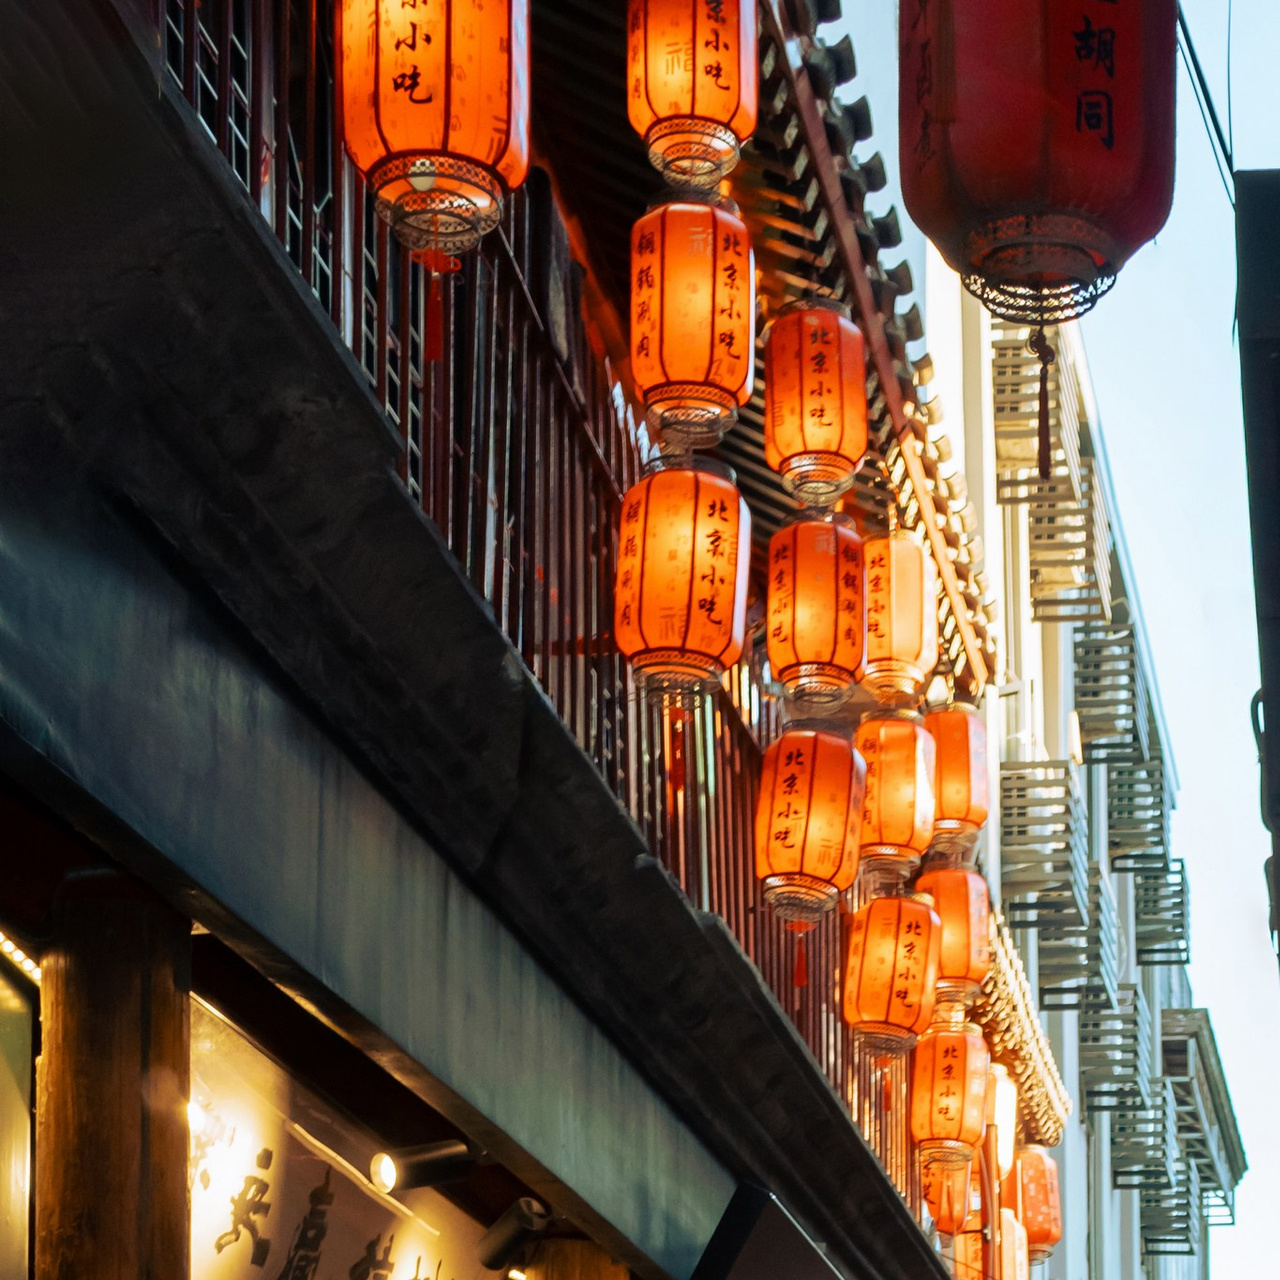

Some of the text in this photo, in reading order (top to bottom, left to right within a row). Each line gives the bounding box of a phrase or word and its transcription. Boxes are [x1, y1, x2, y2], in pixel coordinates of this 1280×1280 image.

[1072, 0, 1119, 151] 胡同
[718, 232, 742, 361] 北京小吃
[808, 328, 832, 427] 北京小吃
[698, 498, 729, 626] 北京小吃
[773, 748, 805, 849] 北京小吃
[895, 921, 922, 1009] 北京小吃
[939, 1045, 958, 1122] 北京小吃
